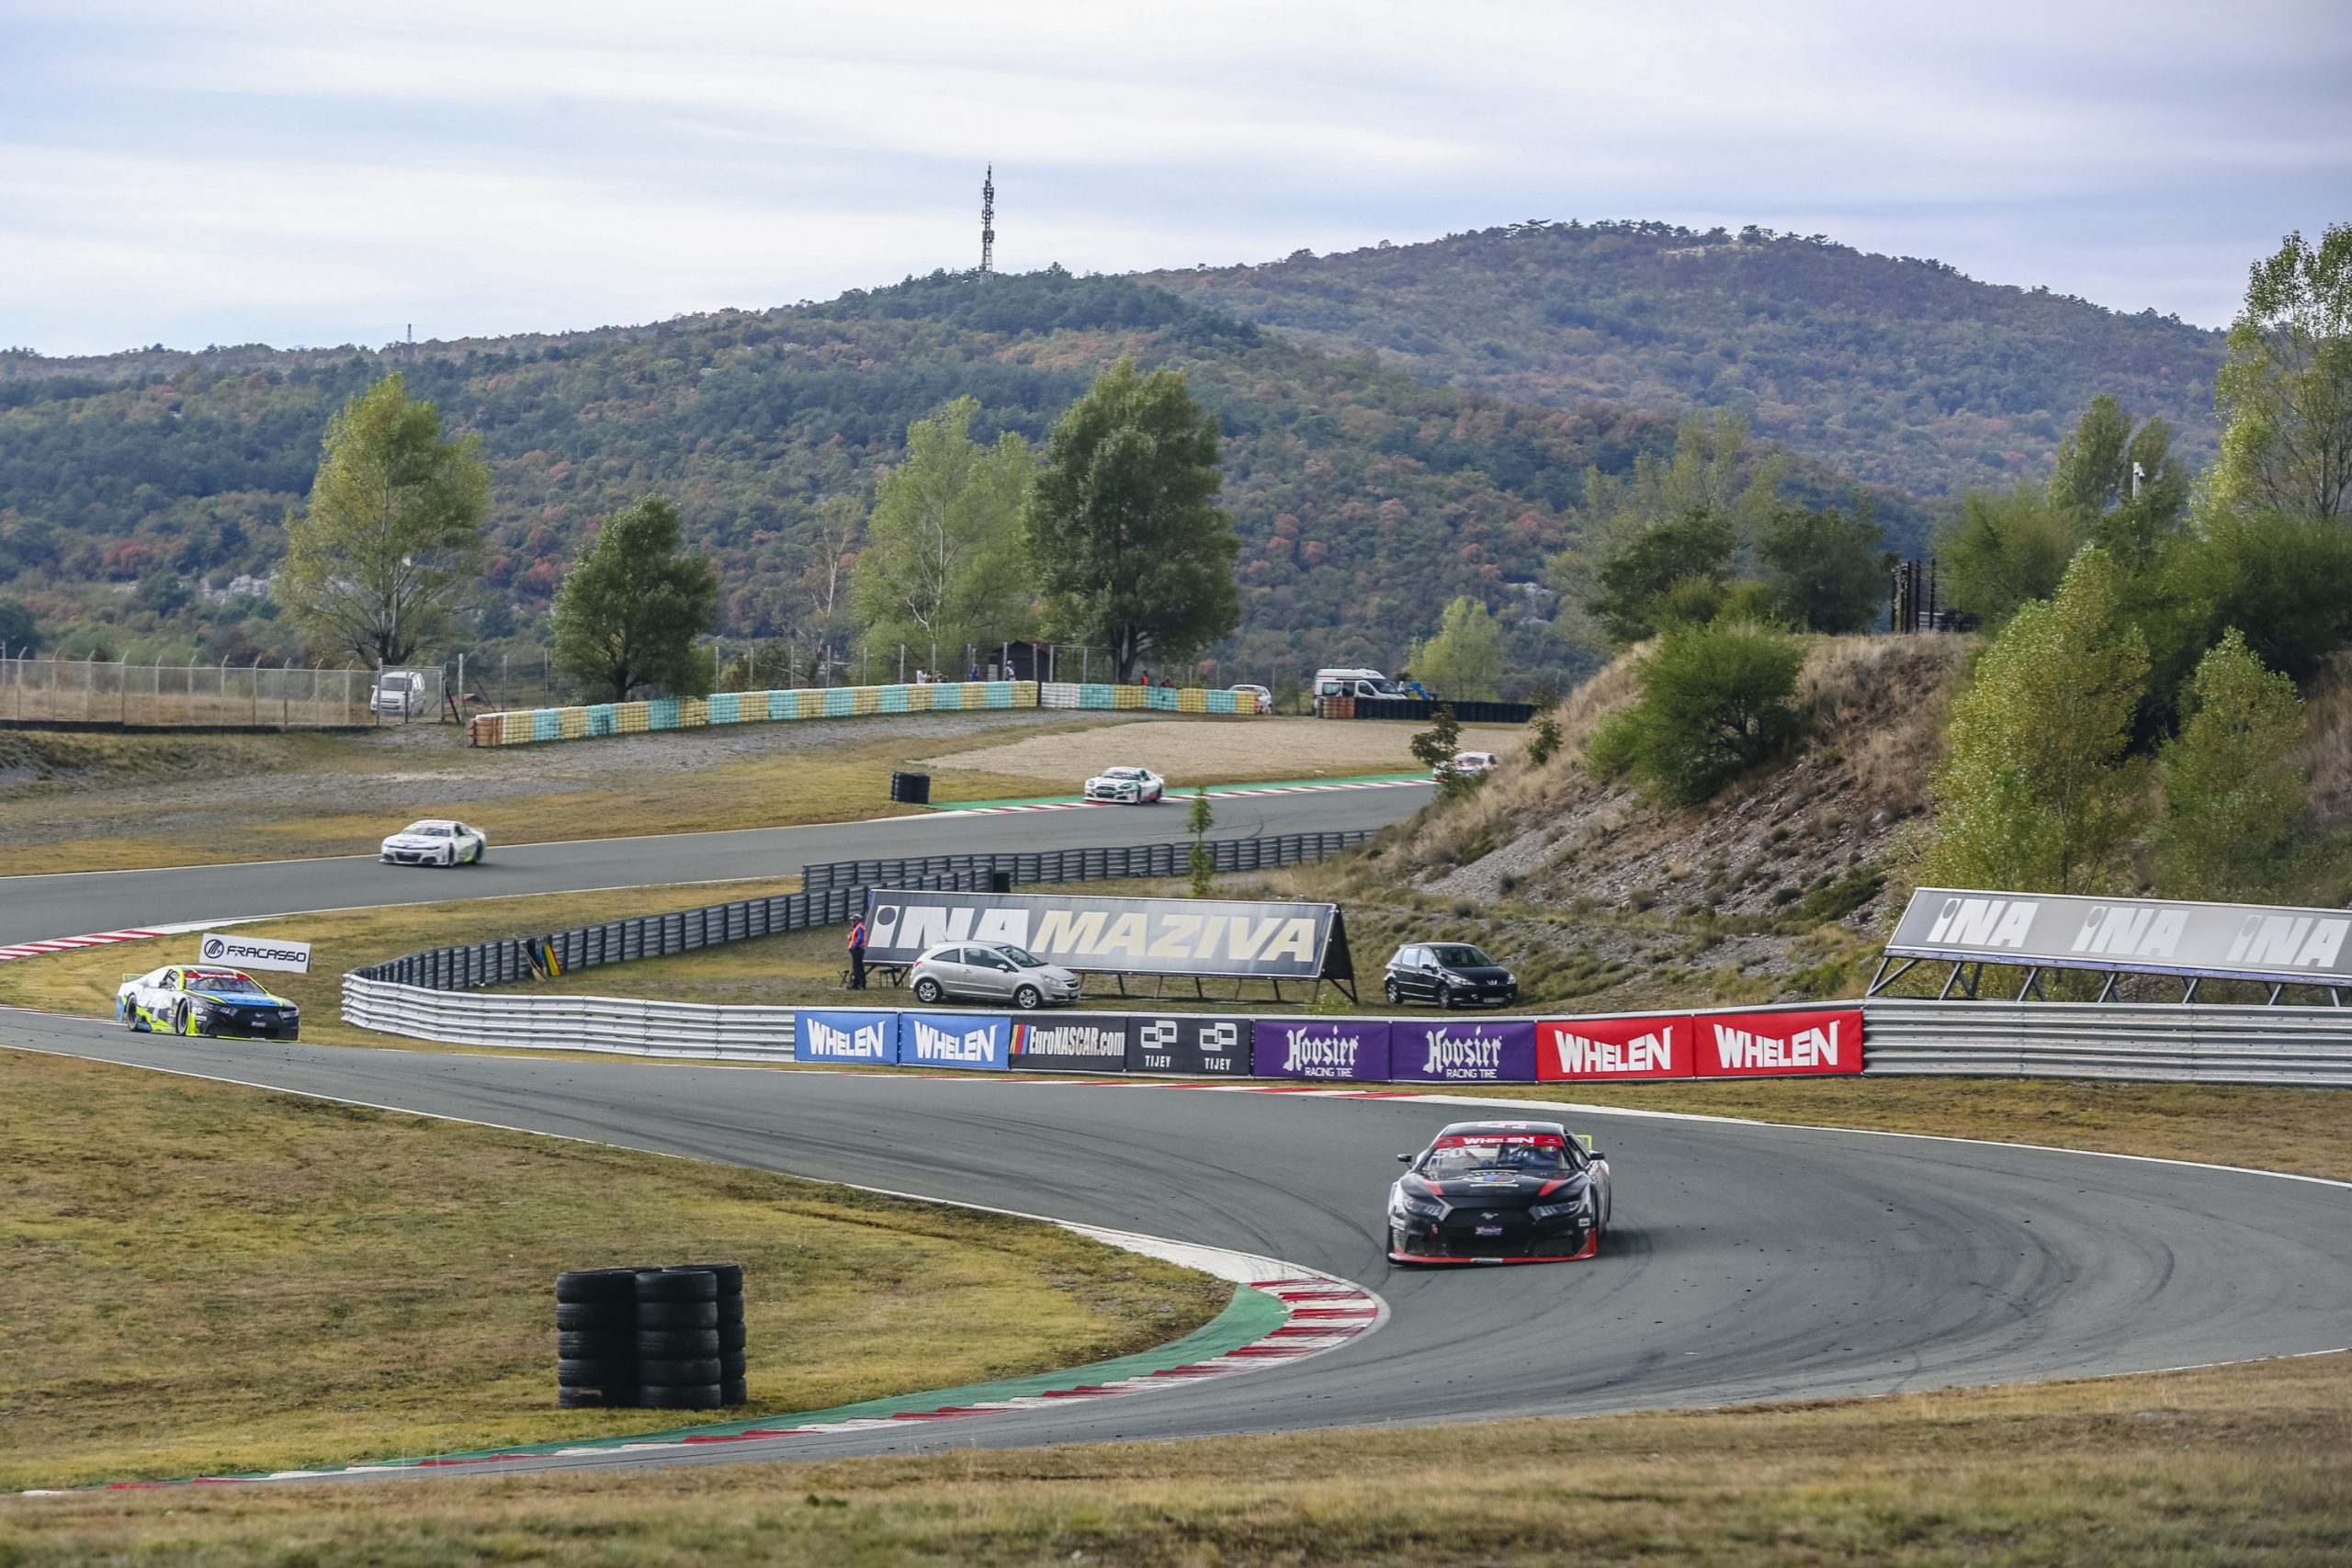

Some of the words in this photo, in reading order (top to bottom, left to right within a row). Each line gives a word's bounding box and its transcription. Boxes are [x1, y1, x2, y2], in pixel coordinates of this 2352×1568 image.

[227, 945, 306, 963] FRACASSO
[1029, 910, 1316, 962] MAZIVA
[808, 1018, 885, 1057] WHELEN
[914, 1021, 998, 1062] WHELEN
[1029, 1026, 1125, 1056] EuroNASCAR.com
[1283, 1025, 1359, 1071] Hoosier
[1422, 1025, 1502, 1074] Hoosier
[1555, 1025, 1673, 1073] WHELEN
[1713, 1020, 1840, 1069] WHELEN
[1145, 1055, 1171, 1068] TIJEY
[1204, 1057, 1231, 1070] TIJEY
[1305, 1066, 1335, 1077] RACING
[1338, 1067, 1352, 1077] TIRE
[1446, 1068, 1477, 1078] RACING
[1479, 1068, 1497, 1078] TIRE
